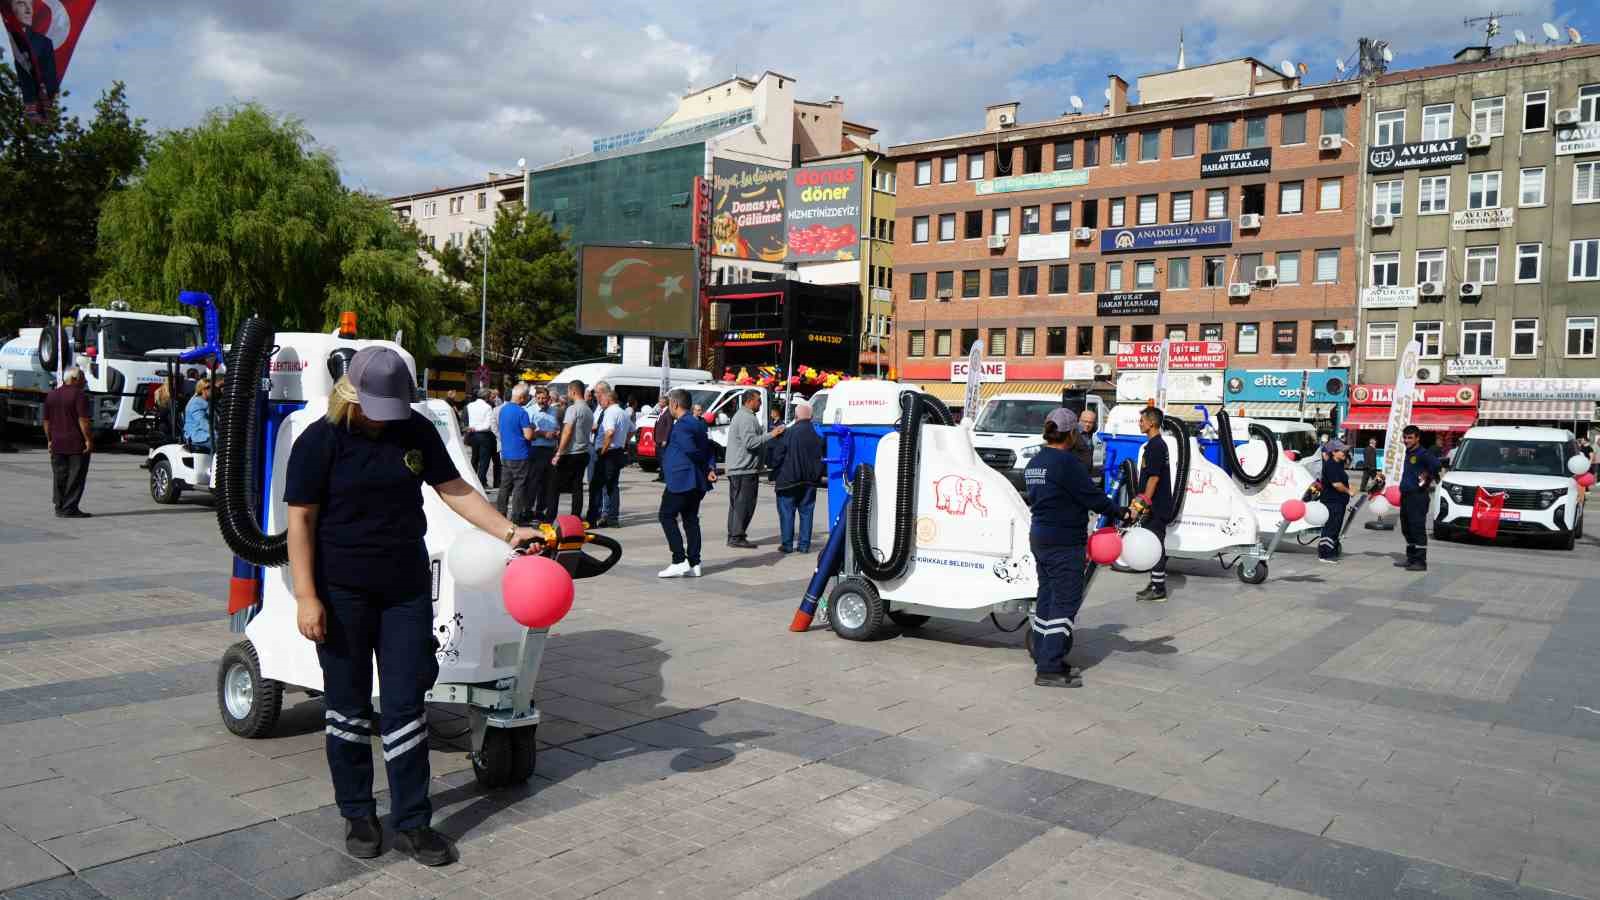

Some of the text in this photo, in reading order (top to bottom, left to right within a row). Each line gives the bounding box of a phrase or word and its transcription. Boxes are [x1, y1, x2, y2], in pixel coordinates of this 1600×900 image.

[1401, 140, 1458, 156] AVUKAT
[1219, 152, 1251, 162] AVUKAT
[795, 167, 855, 187] donas
[801, 186, 849, 202] döner
[732, 201, 765, 213] Donas
[738, 213, 782, 226] Gülümse
[1137, 225, 1216, 239] ANADOLU AJANSI
[953, 364, 1003, 375] ECANE
[1253, 374, 1288, 386] elite
